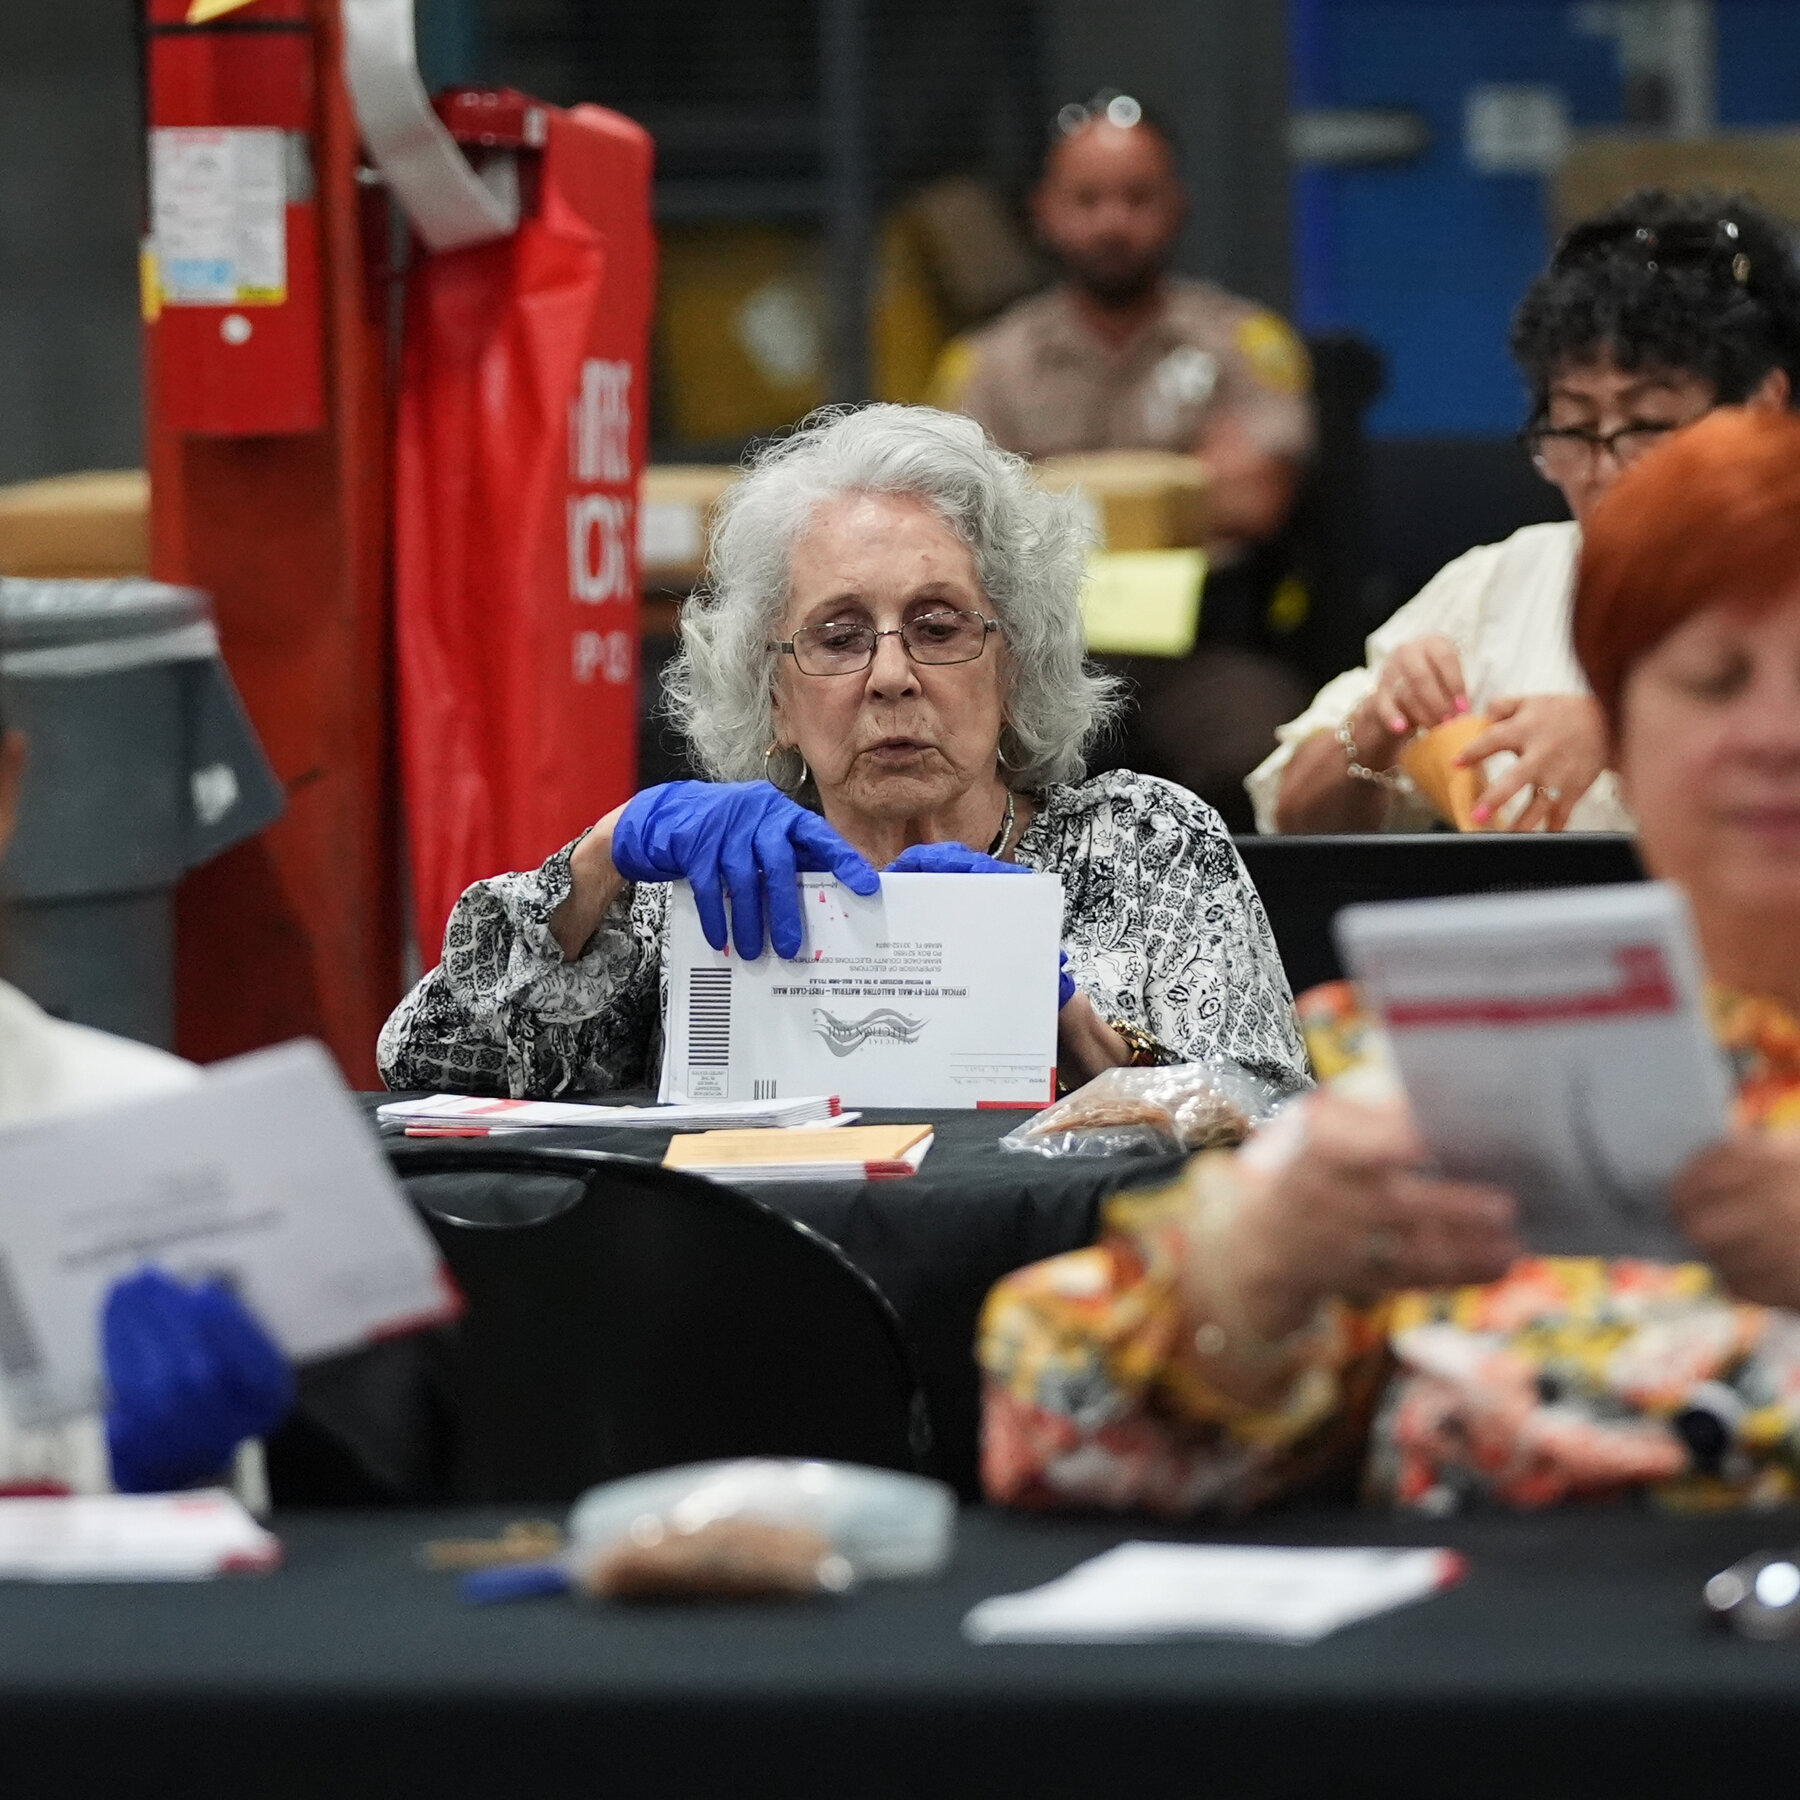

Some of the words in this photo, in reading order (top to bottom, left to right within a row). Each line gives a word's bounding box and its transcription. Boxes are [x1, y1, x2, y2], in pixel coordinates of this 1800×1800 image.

[772, 987, 788, 995] MAIL
[789, 987, 825, 995] FIRST-CLASS
[862, 988, 896, 996] BALLOTING
[898, 988, 939, 996] VOTE-BY-MAIL
[941, 988, 967, 996] OFFICIAL
